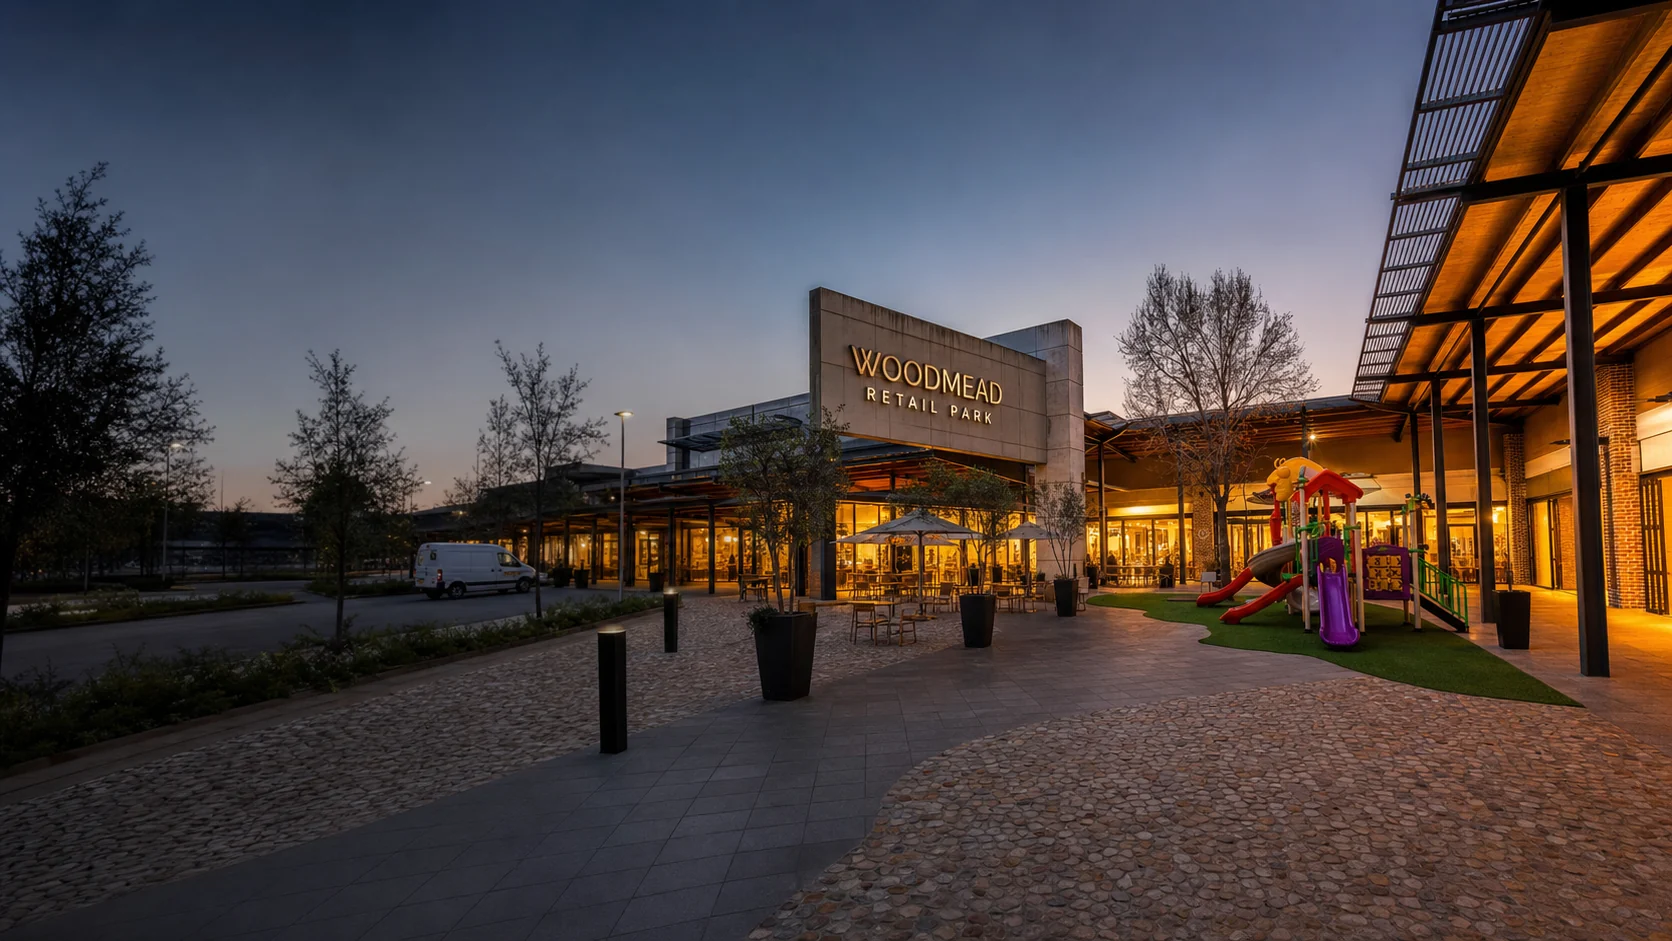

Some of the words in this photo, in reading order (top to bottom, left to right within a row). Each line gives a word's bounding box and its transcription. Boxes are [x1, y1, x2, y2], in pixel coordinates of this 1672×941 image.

[850, 345, 1002, 405] WOODMEAD
[866, 387, 938, 414] RETAIL
[949, 405, 992, 425] PARK
